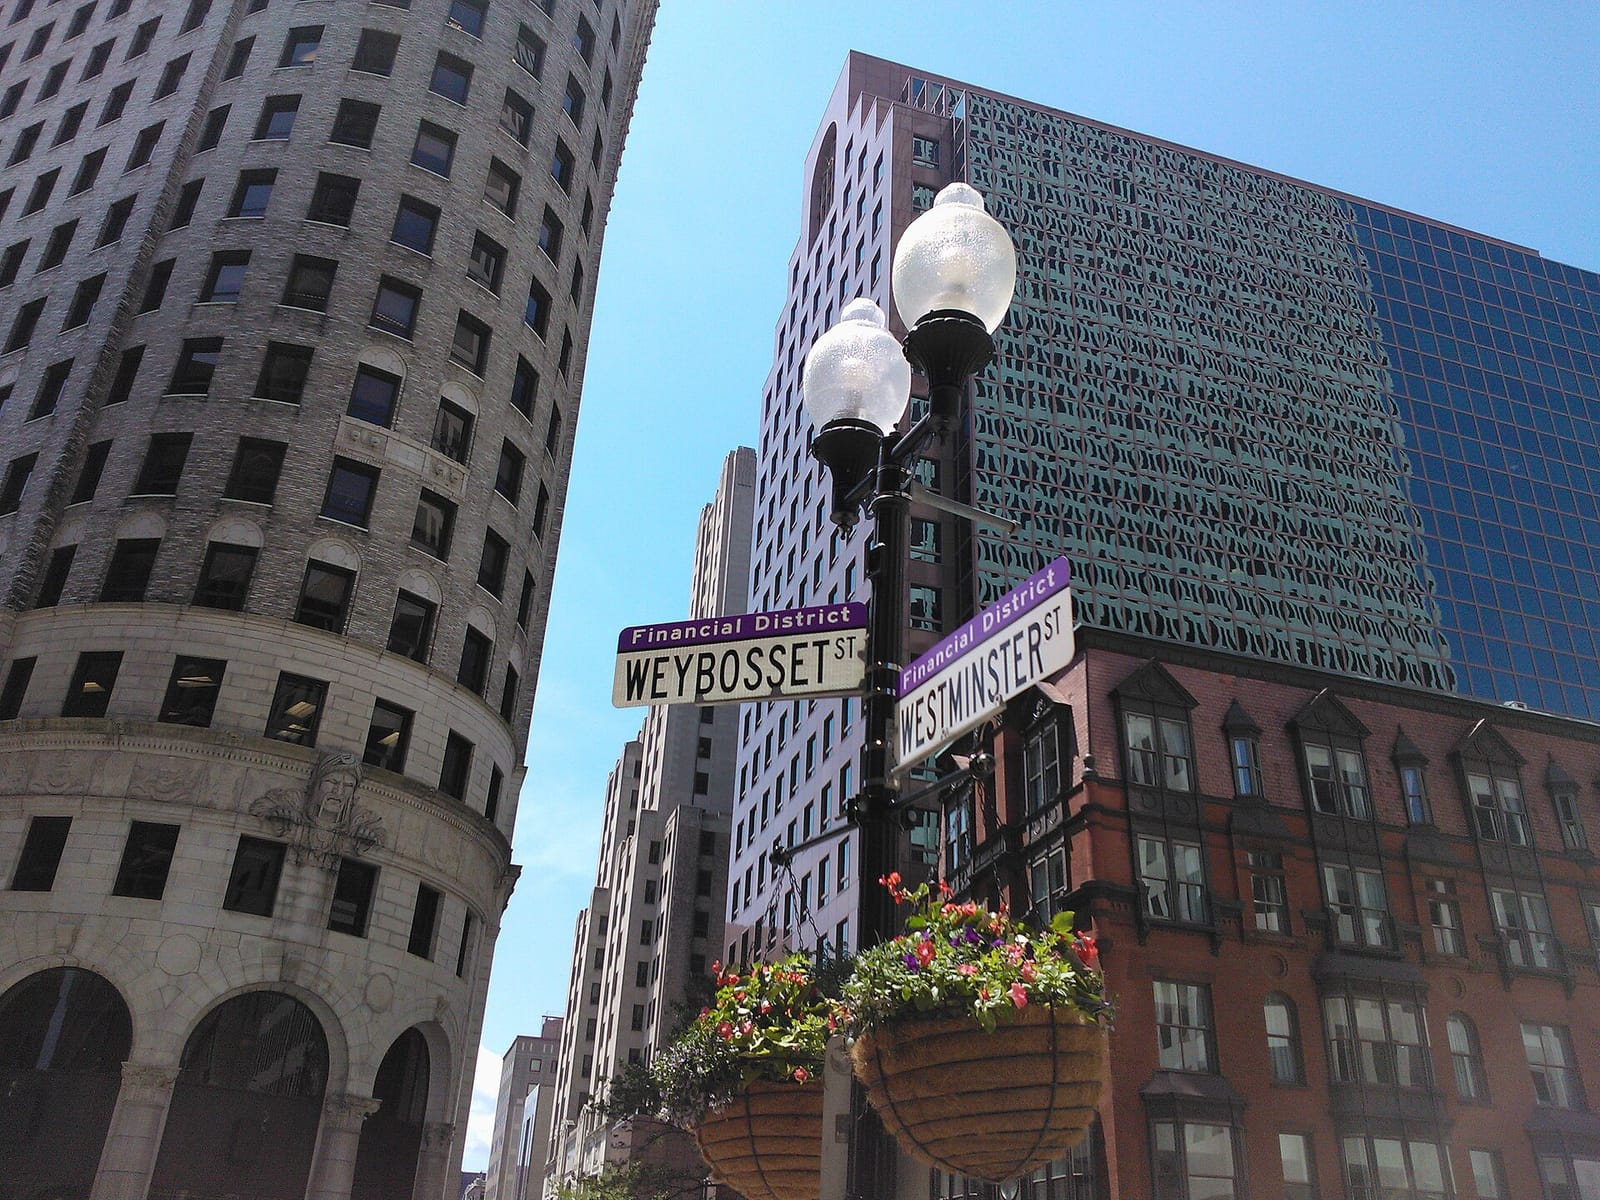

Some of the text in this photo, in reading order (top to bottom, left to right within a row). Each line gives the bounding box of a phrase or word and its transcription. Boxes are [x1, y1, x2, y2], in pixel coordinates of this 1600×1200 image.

[626, 637, 856, 701] WEYBOSSET ST
[632, 606, 850, 644] Financial District
[903, 568, 1056, 690] Financial District
[901, 606, 1061, 757] WESTMINSTER ST
